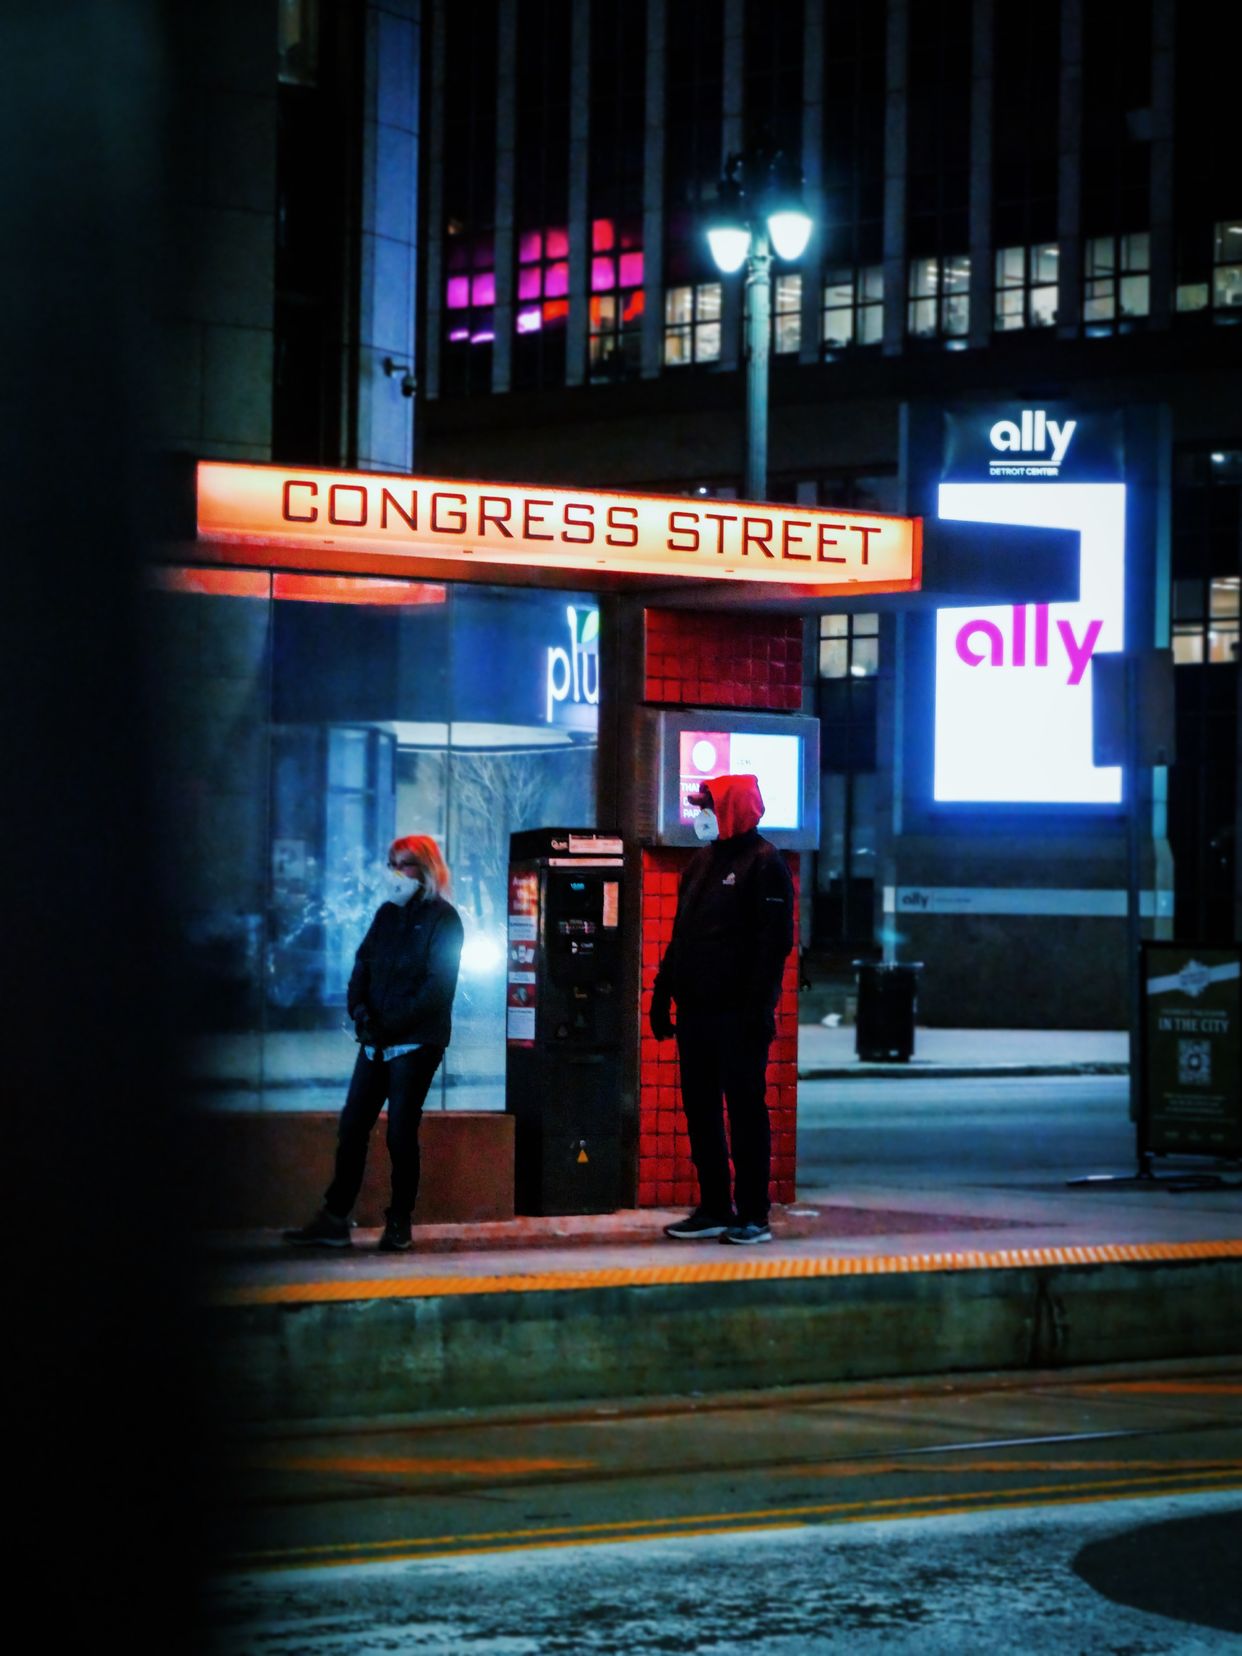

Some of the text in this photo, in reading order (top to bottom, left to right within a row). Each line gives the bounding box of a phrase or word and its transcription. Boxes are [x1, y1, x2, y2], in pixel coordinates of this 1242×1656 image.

[990, 410, 1077, 461] ally
[990, 467, 1059, 476] DETROIT CENTER
[282, 480, 882, 566] CONGRESS STREET
[956, 603, 1104, 685] ally
